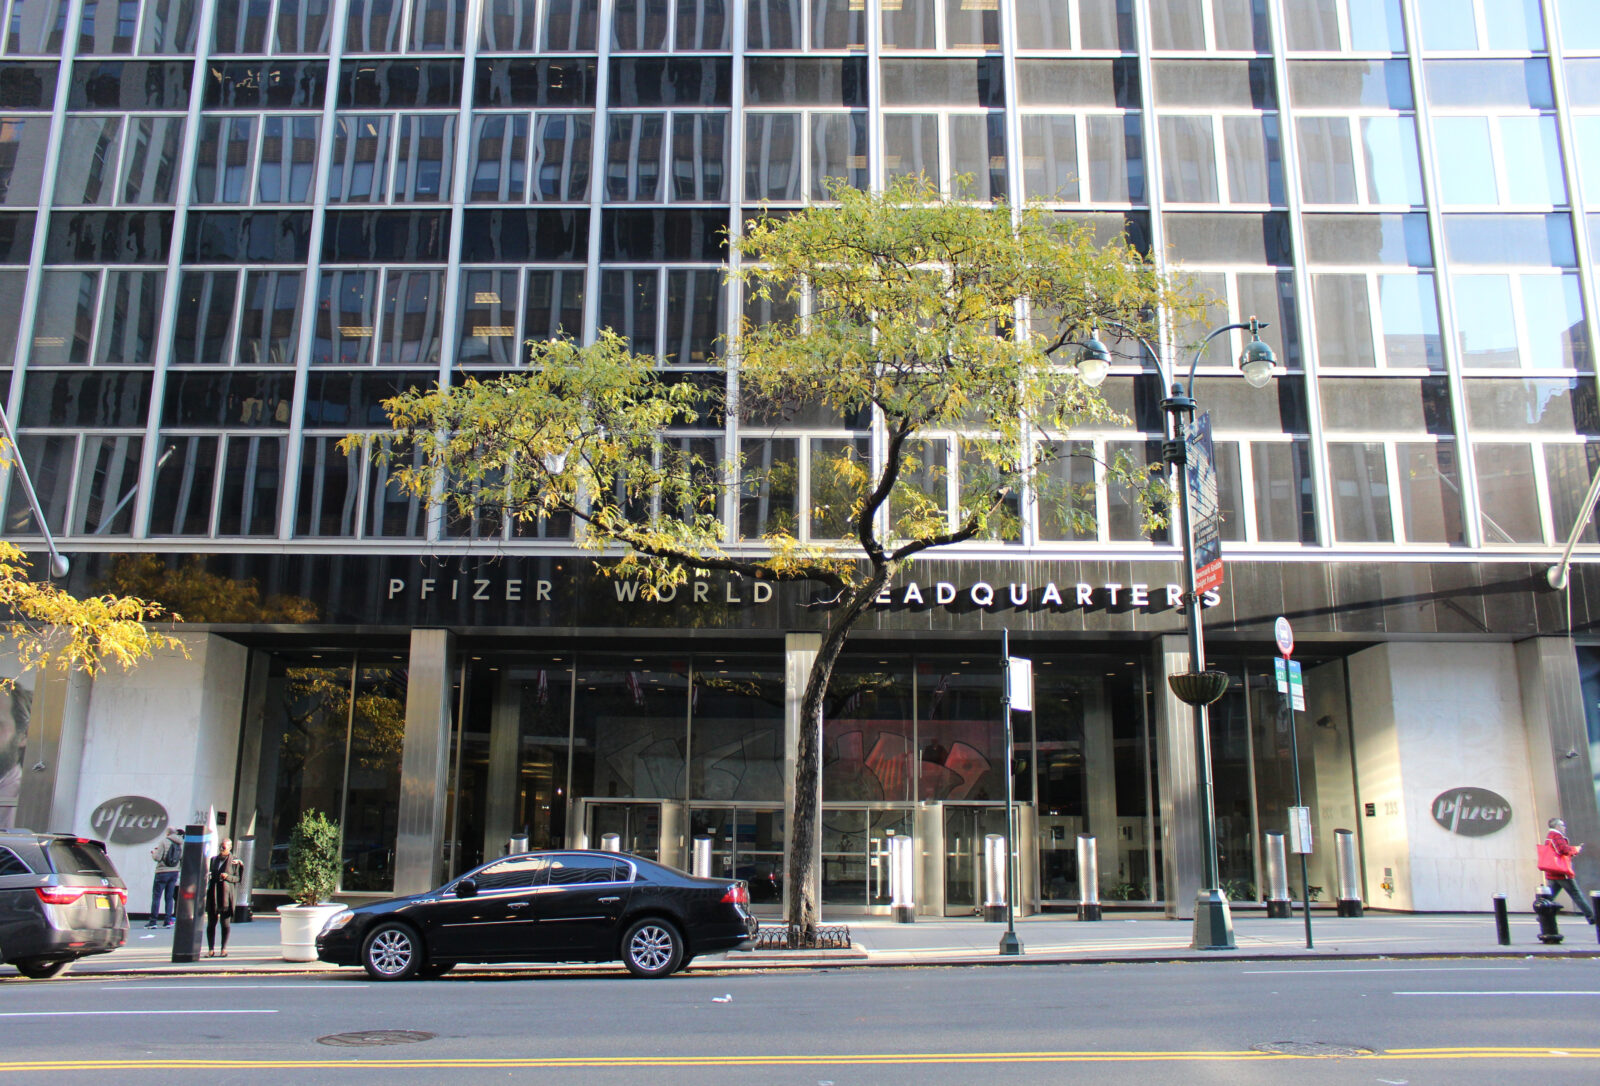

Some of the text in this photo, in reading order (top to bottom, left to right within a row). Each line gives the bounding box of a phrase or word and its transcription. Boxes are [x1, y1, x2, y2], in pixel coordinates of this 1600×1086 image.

[388, 578, 1222, 607] PFIZER WORLD EADQUARTERS
[95, 800, 167, 841] Pfizer
[1436, 793, 1510, 834] Pfizer
